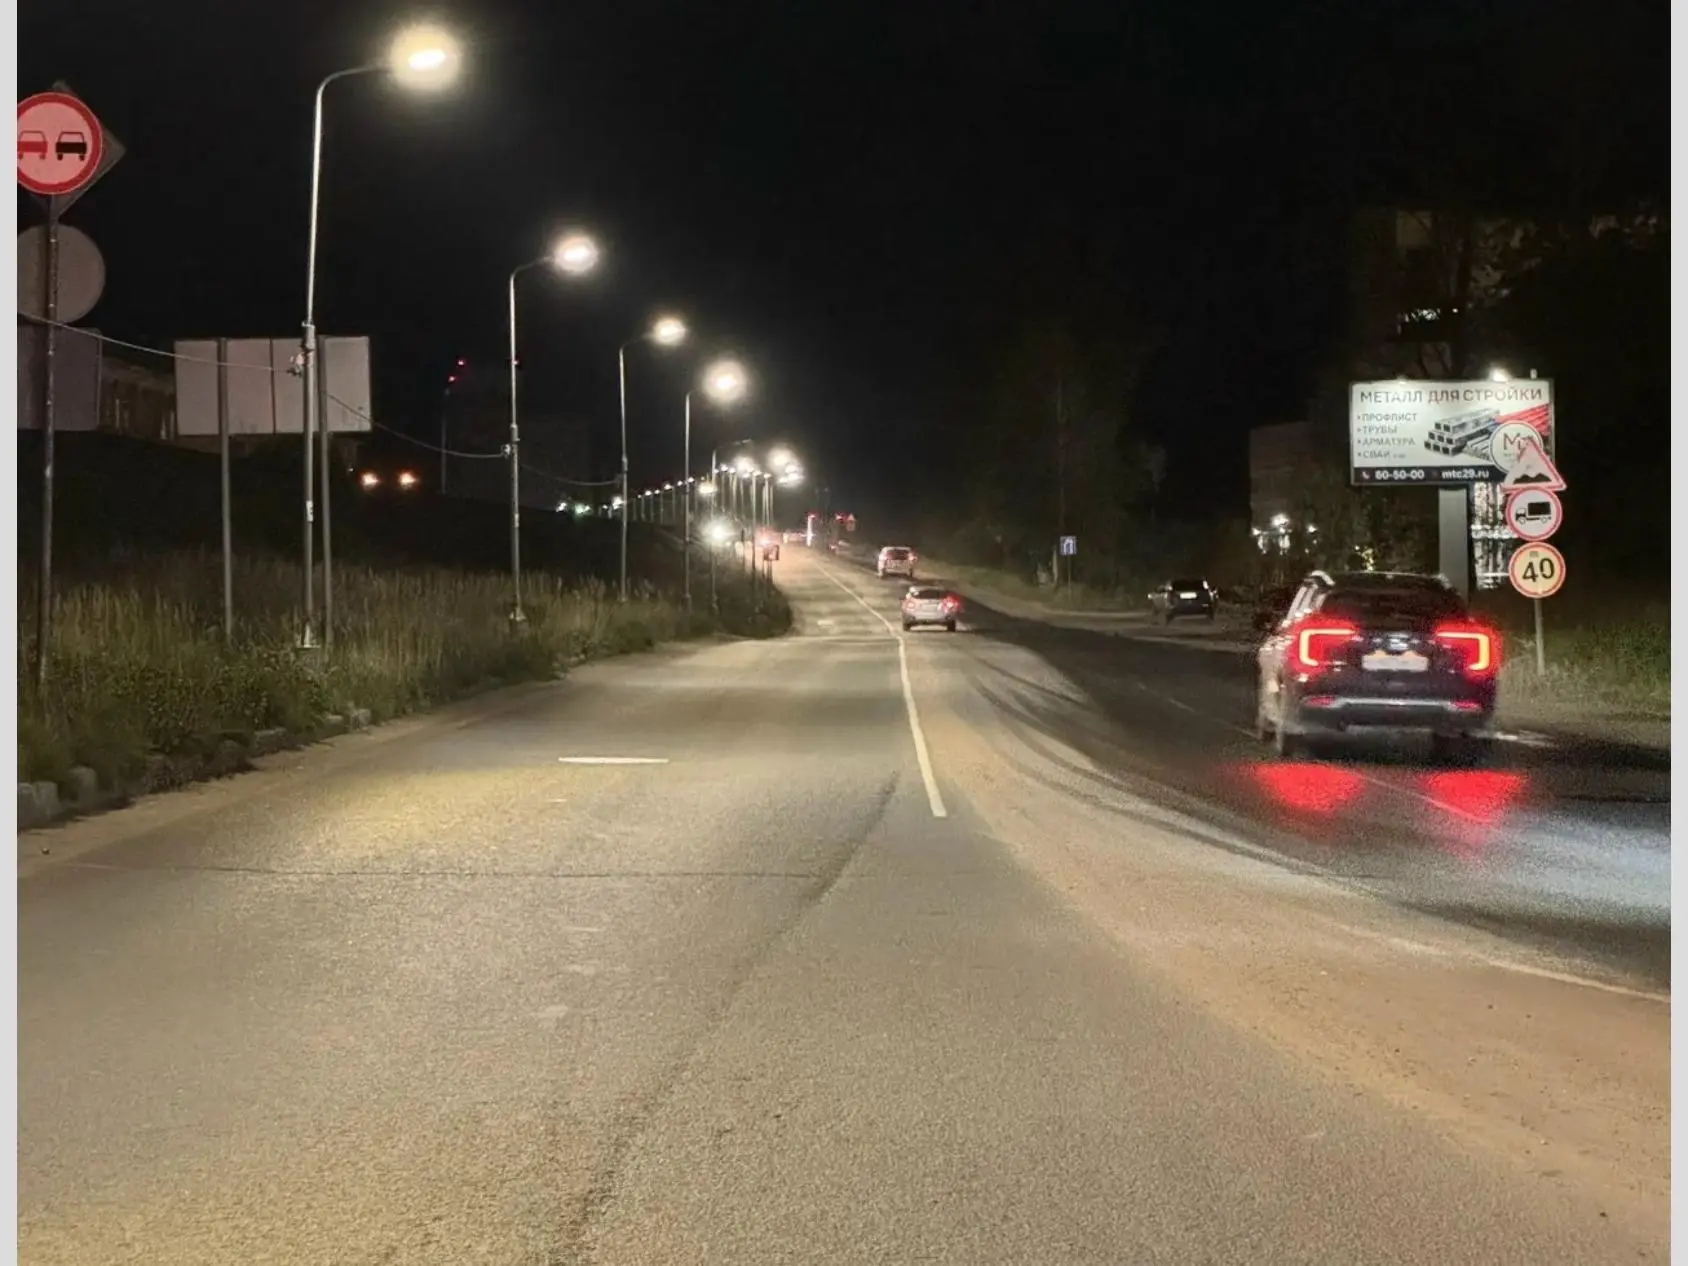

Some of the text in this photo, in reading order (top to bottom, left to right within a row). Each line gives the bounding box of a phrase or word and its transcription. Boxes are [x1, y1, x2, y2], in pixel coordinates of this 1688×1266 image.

[1360, 387, 1542, 404] МЕТАЛЛ ДЛЯ СТРОЙКИ
[1361, 412, 1417, 421] ПРОФЛИСТ
[1362, 425, 1398, 434] ТРУБЫ
[1361, 437, 1416, 446] АРМАТУРА
[1441, 468, 1490, 479] mtc29.ru
[1522, 557, 1555, 582] 40
